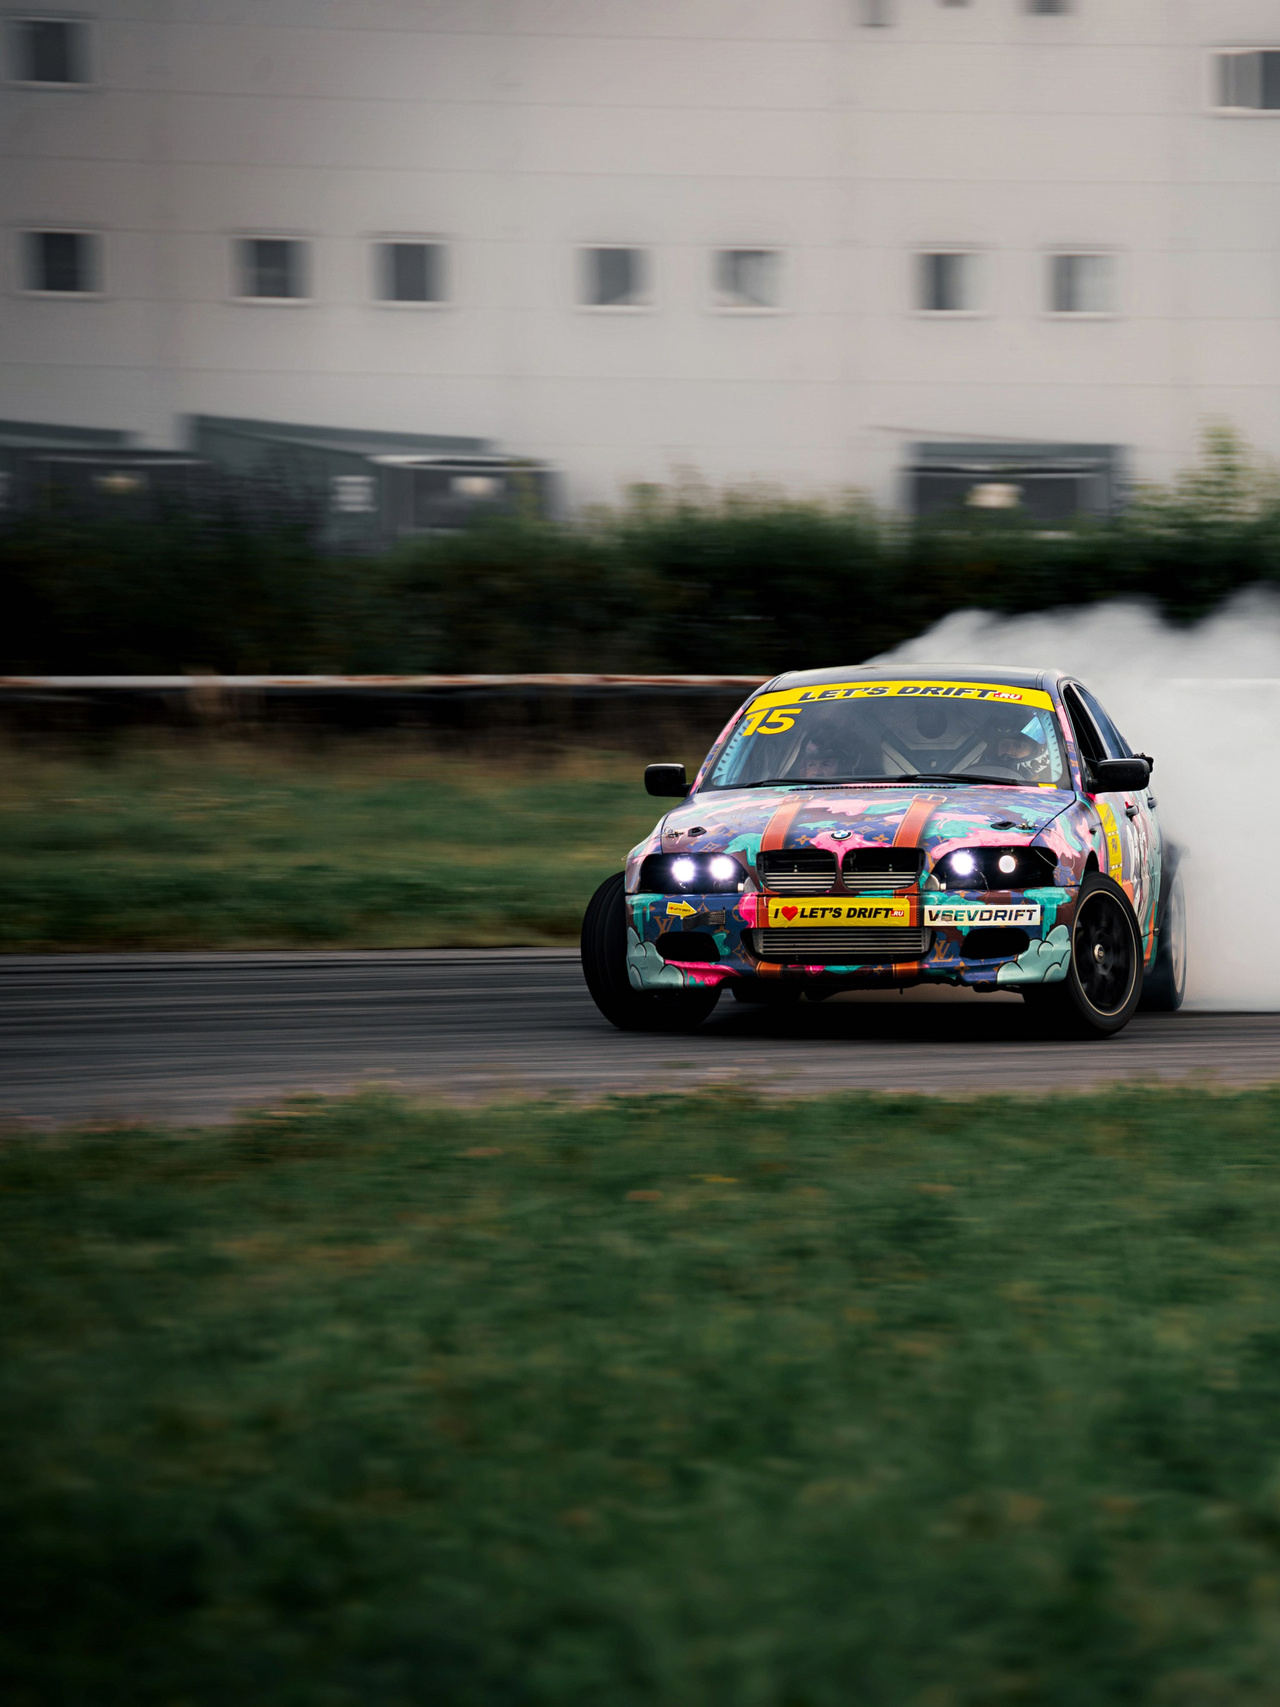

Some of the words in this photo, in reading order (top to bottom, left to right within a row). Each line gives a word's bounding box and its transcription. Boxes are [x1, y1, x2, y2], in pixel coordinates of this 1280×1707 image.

[798, 687, 890, 701] LET'S
[742, 708, 802, 736] 15
[774, 908, 780, 919] I
[800, 908, 842, 919] LET'S
[928, 909, 1037, 922] VSEVDRIFT
